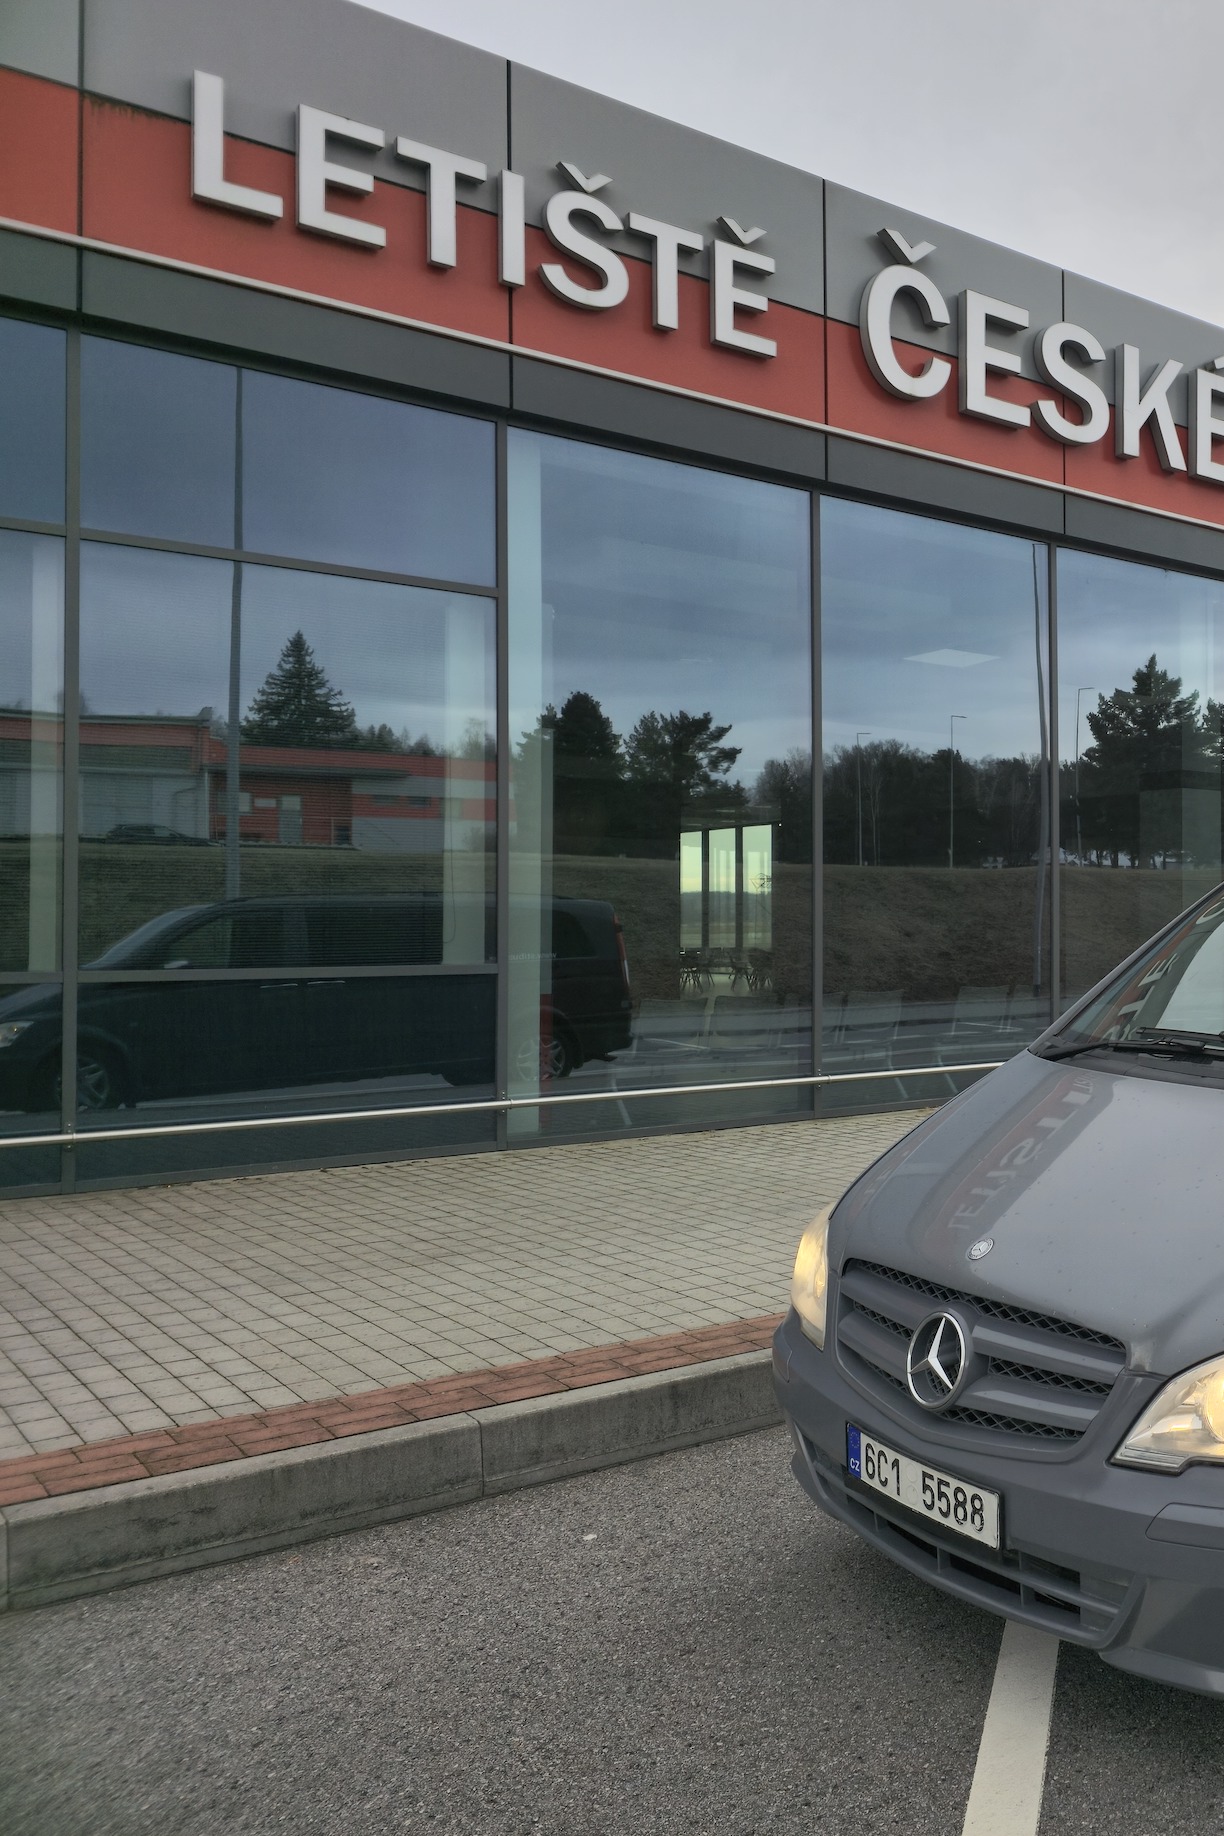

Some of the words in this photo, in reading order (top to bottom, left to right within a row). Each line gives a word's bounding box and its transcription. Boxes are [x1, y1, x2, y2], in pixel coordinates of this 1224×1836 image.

[190, 70, 777, 359] LETIŠTĚ
[850, 1457, 860, 1472] CZ
[865, 1443, 900, 1496] 6C1
[922, 1470, 984, 1532] 5588
